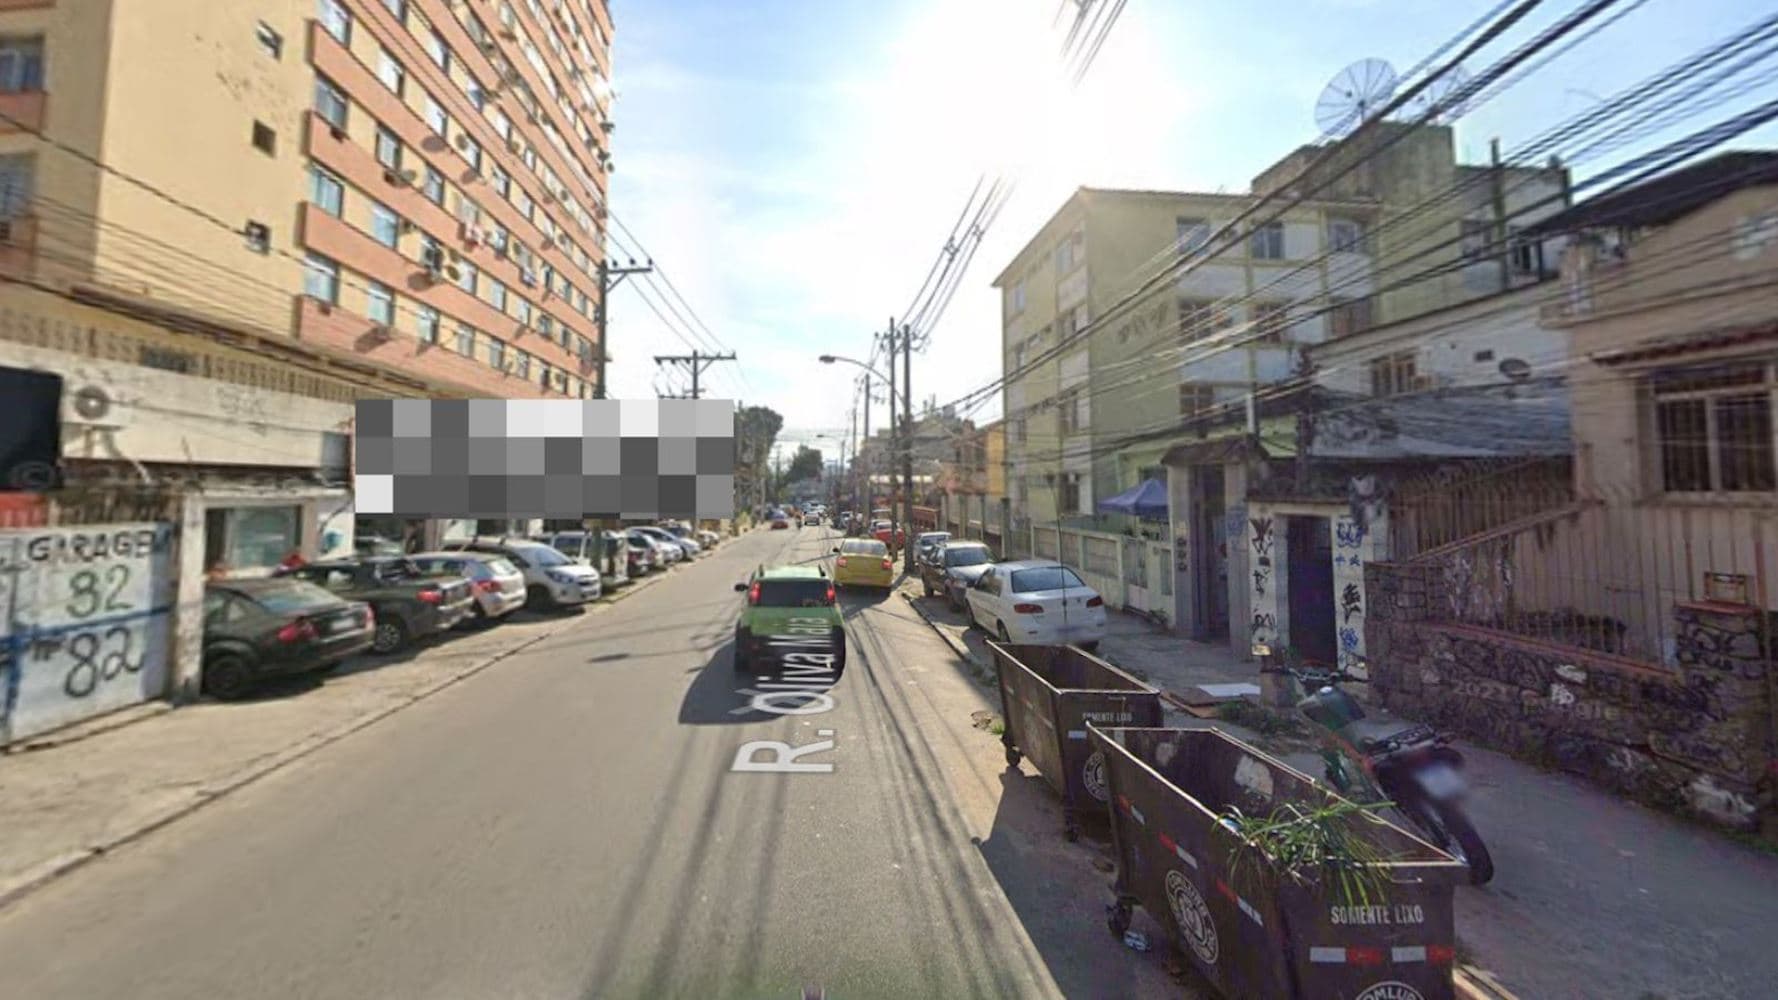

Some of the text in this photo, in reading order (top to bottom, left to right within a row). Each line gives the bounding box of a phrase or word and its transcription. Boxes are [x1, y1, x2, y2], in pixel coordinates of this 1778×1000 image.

[64, 626, 145, 697] 82
[1330, 904, 1425, 925] SOMENTE LIXO
